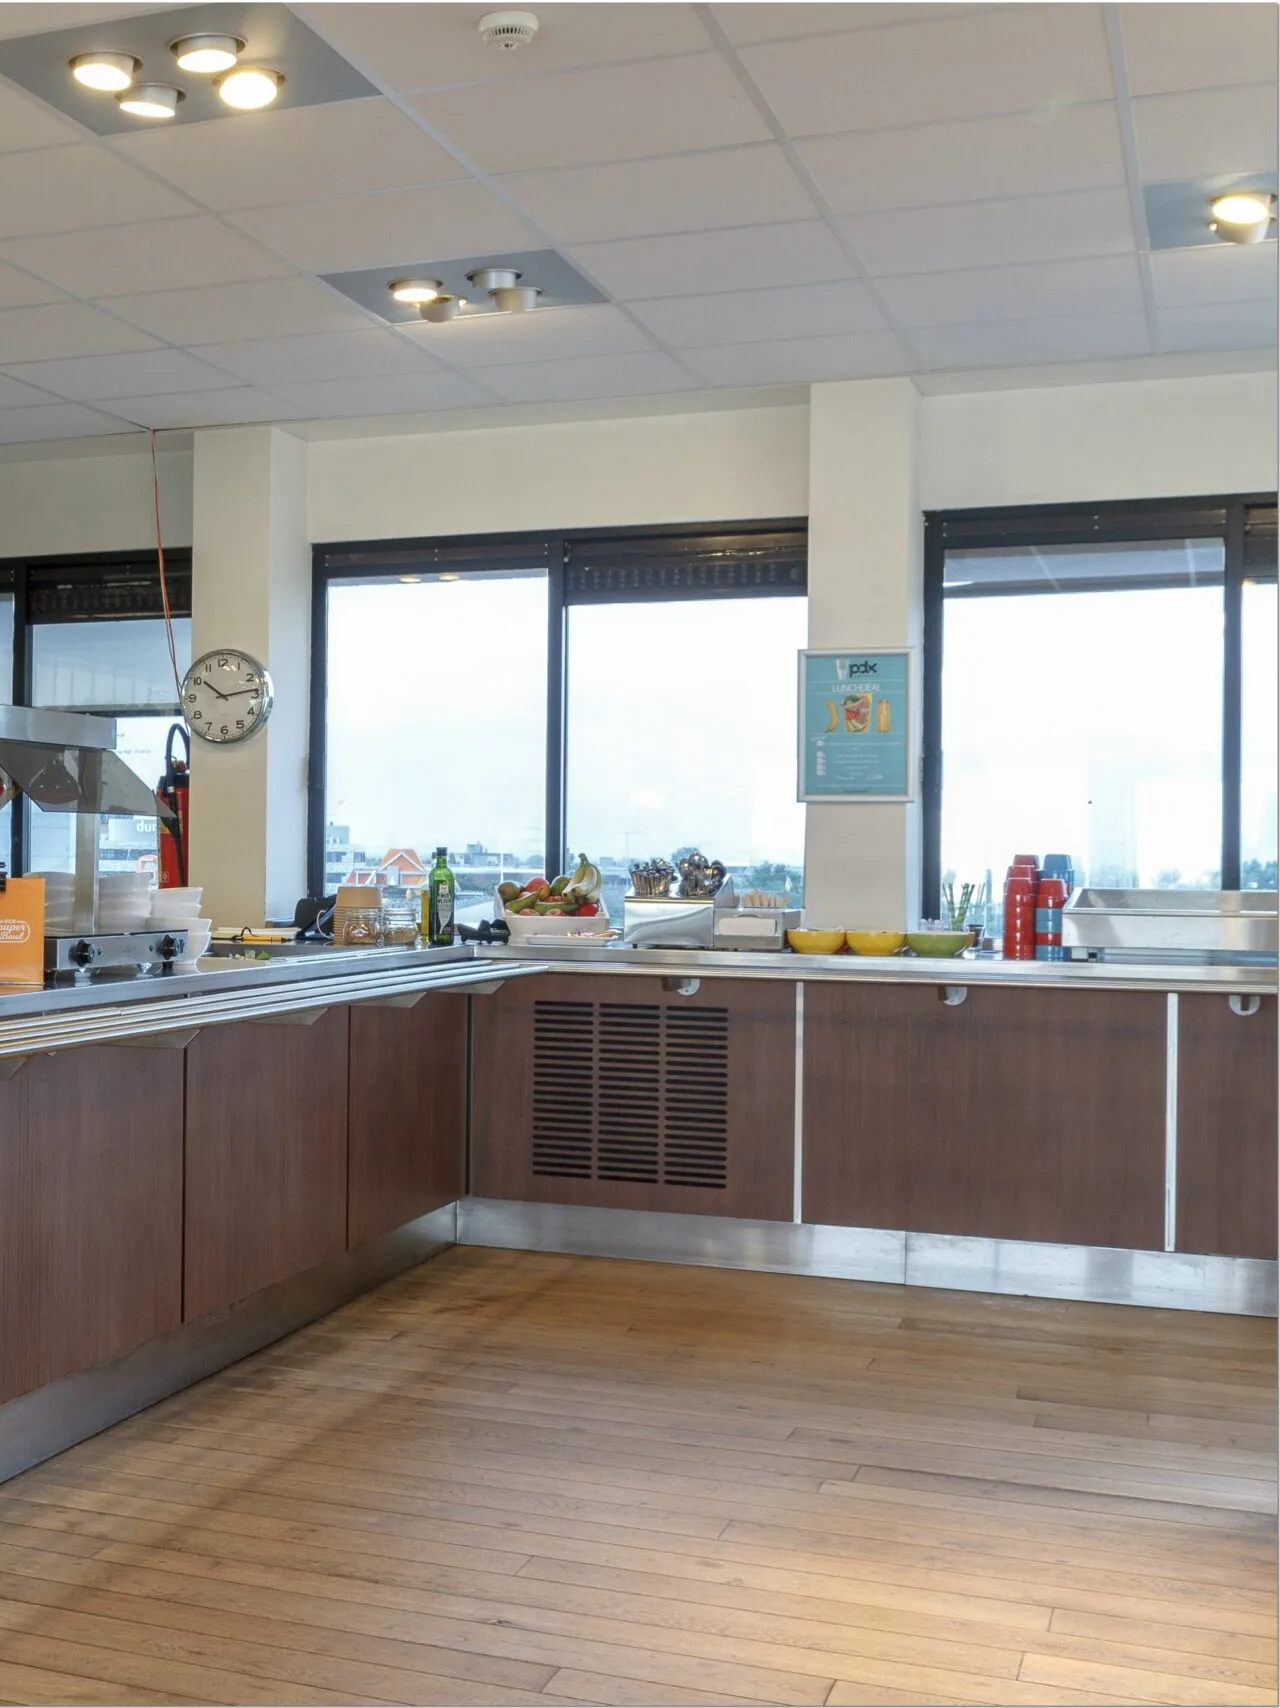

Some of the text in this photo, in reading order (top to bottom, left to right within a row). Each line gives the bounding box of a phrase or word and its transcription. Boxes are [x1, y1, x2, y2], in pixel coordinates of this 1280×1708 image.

[218, 659, 229, 667] 12
[205, 664, 212, 672] 11
[849, 660, 878, 678] pdx
[193, 677, 202, 685] 10
[246, 674, 254, 682] 2
[831, 683, 881, 692] LUNCHDEAL
[188, 694, 197, 702] 9
[251, 690, 259, 699] 3
[193, 710, 202, 719] 8
[247, 708, 255, 716] 4
[205, 722, 212, 731] 7
[236, 720, 245, 729] 5
[220, 726, 228, 734] 6
[0, 931, 24, 940] Bowl
